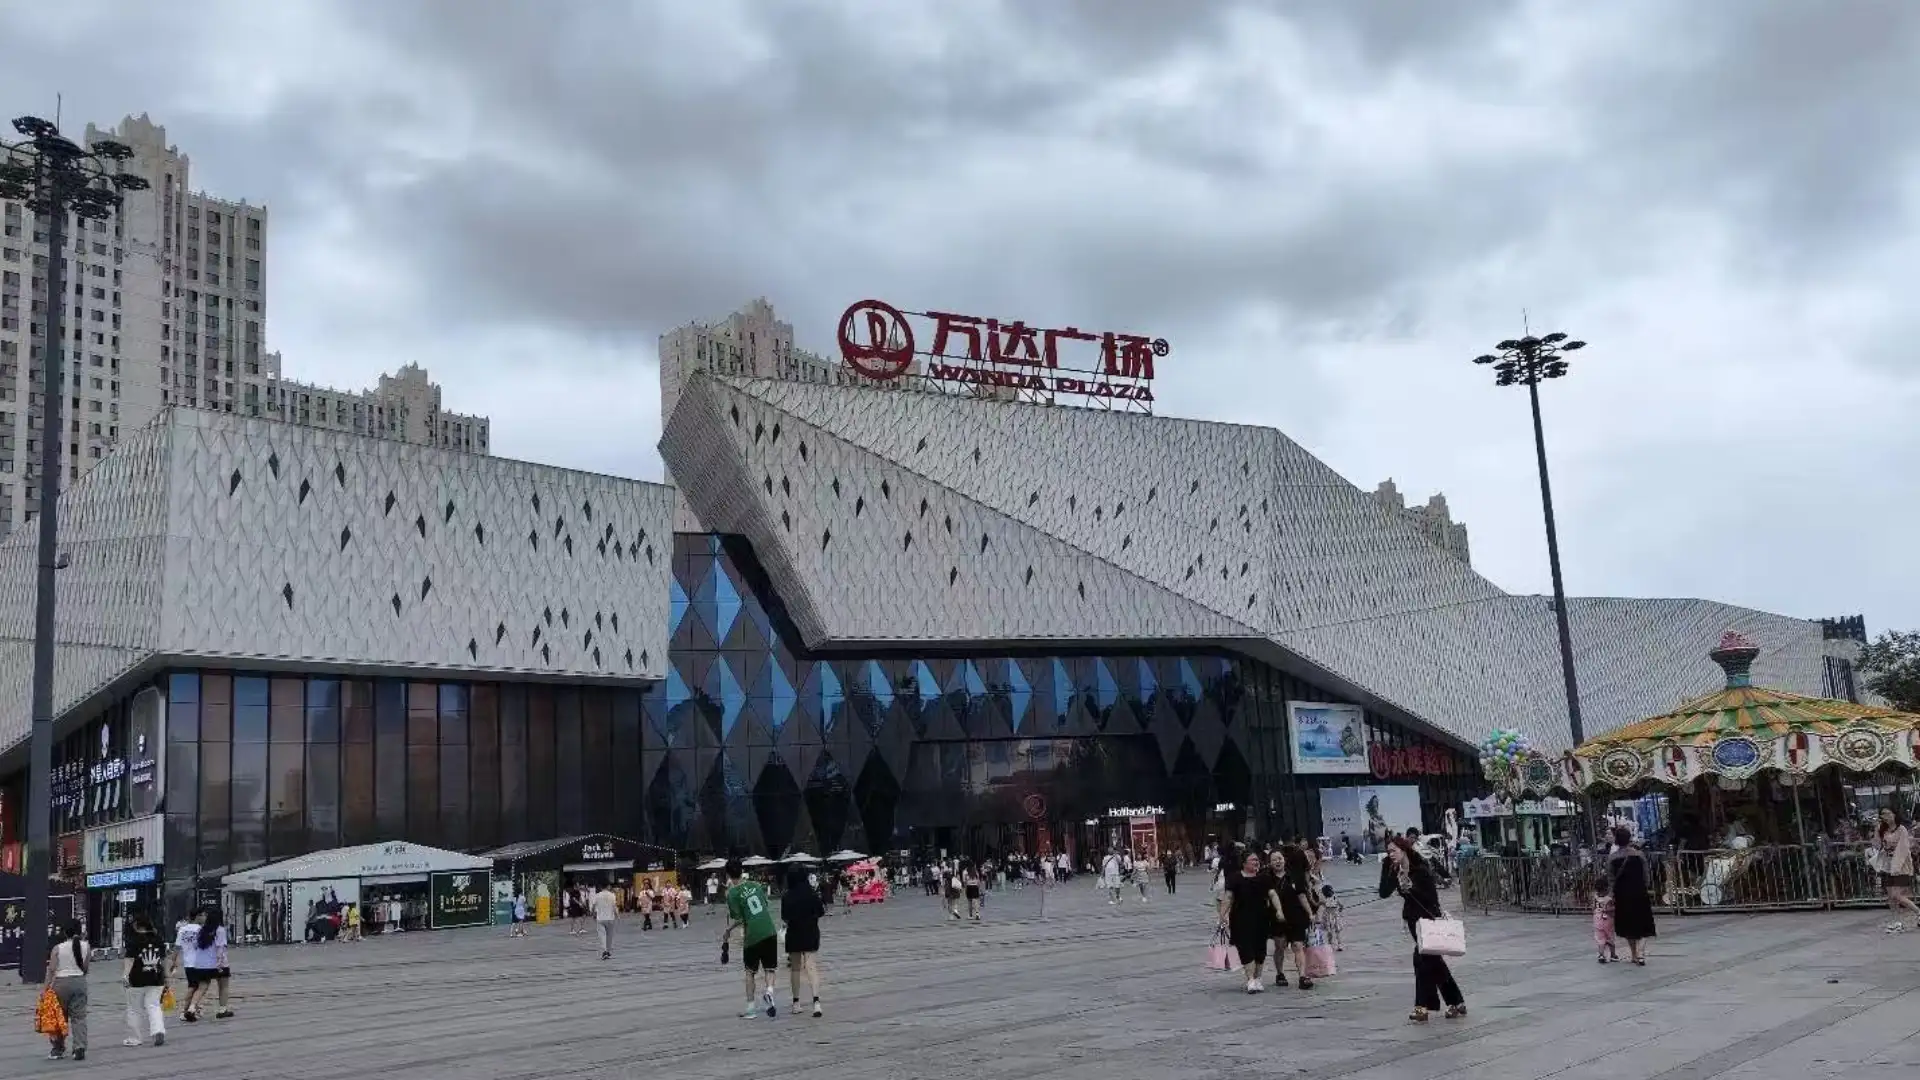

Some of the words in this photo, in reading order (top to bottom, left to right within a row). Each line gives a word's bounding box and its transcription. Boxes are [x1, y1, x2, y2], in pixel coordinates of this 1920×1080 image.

[927, 311, 1154, 379] 万达广场
[929, 363, 1046, 391] WANDA
[1055, 377, 1155, 402] PLAZA
[582, 843, 602, 852] Jack
[747, 895, 763, 915] 0
